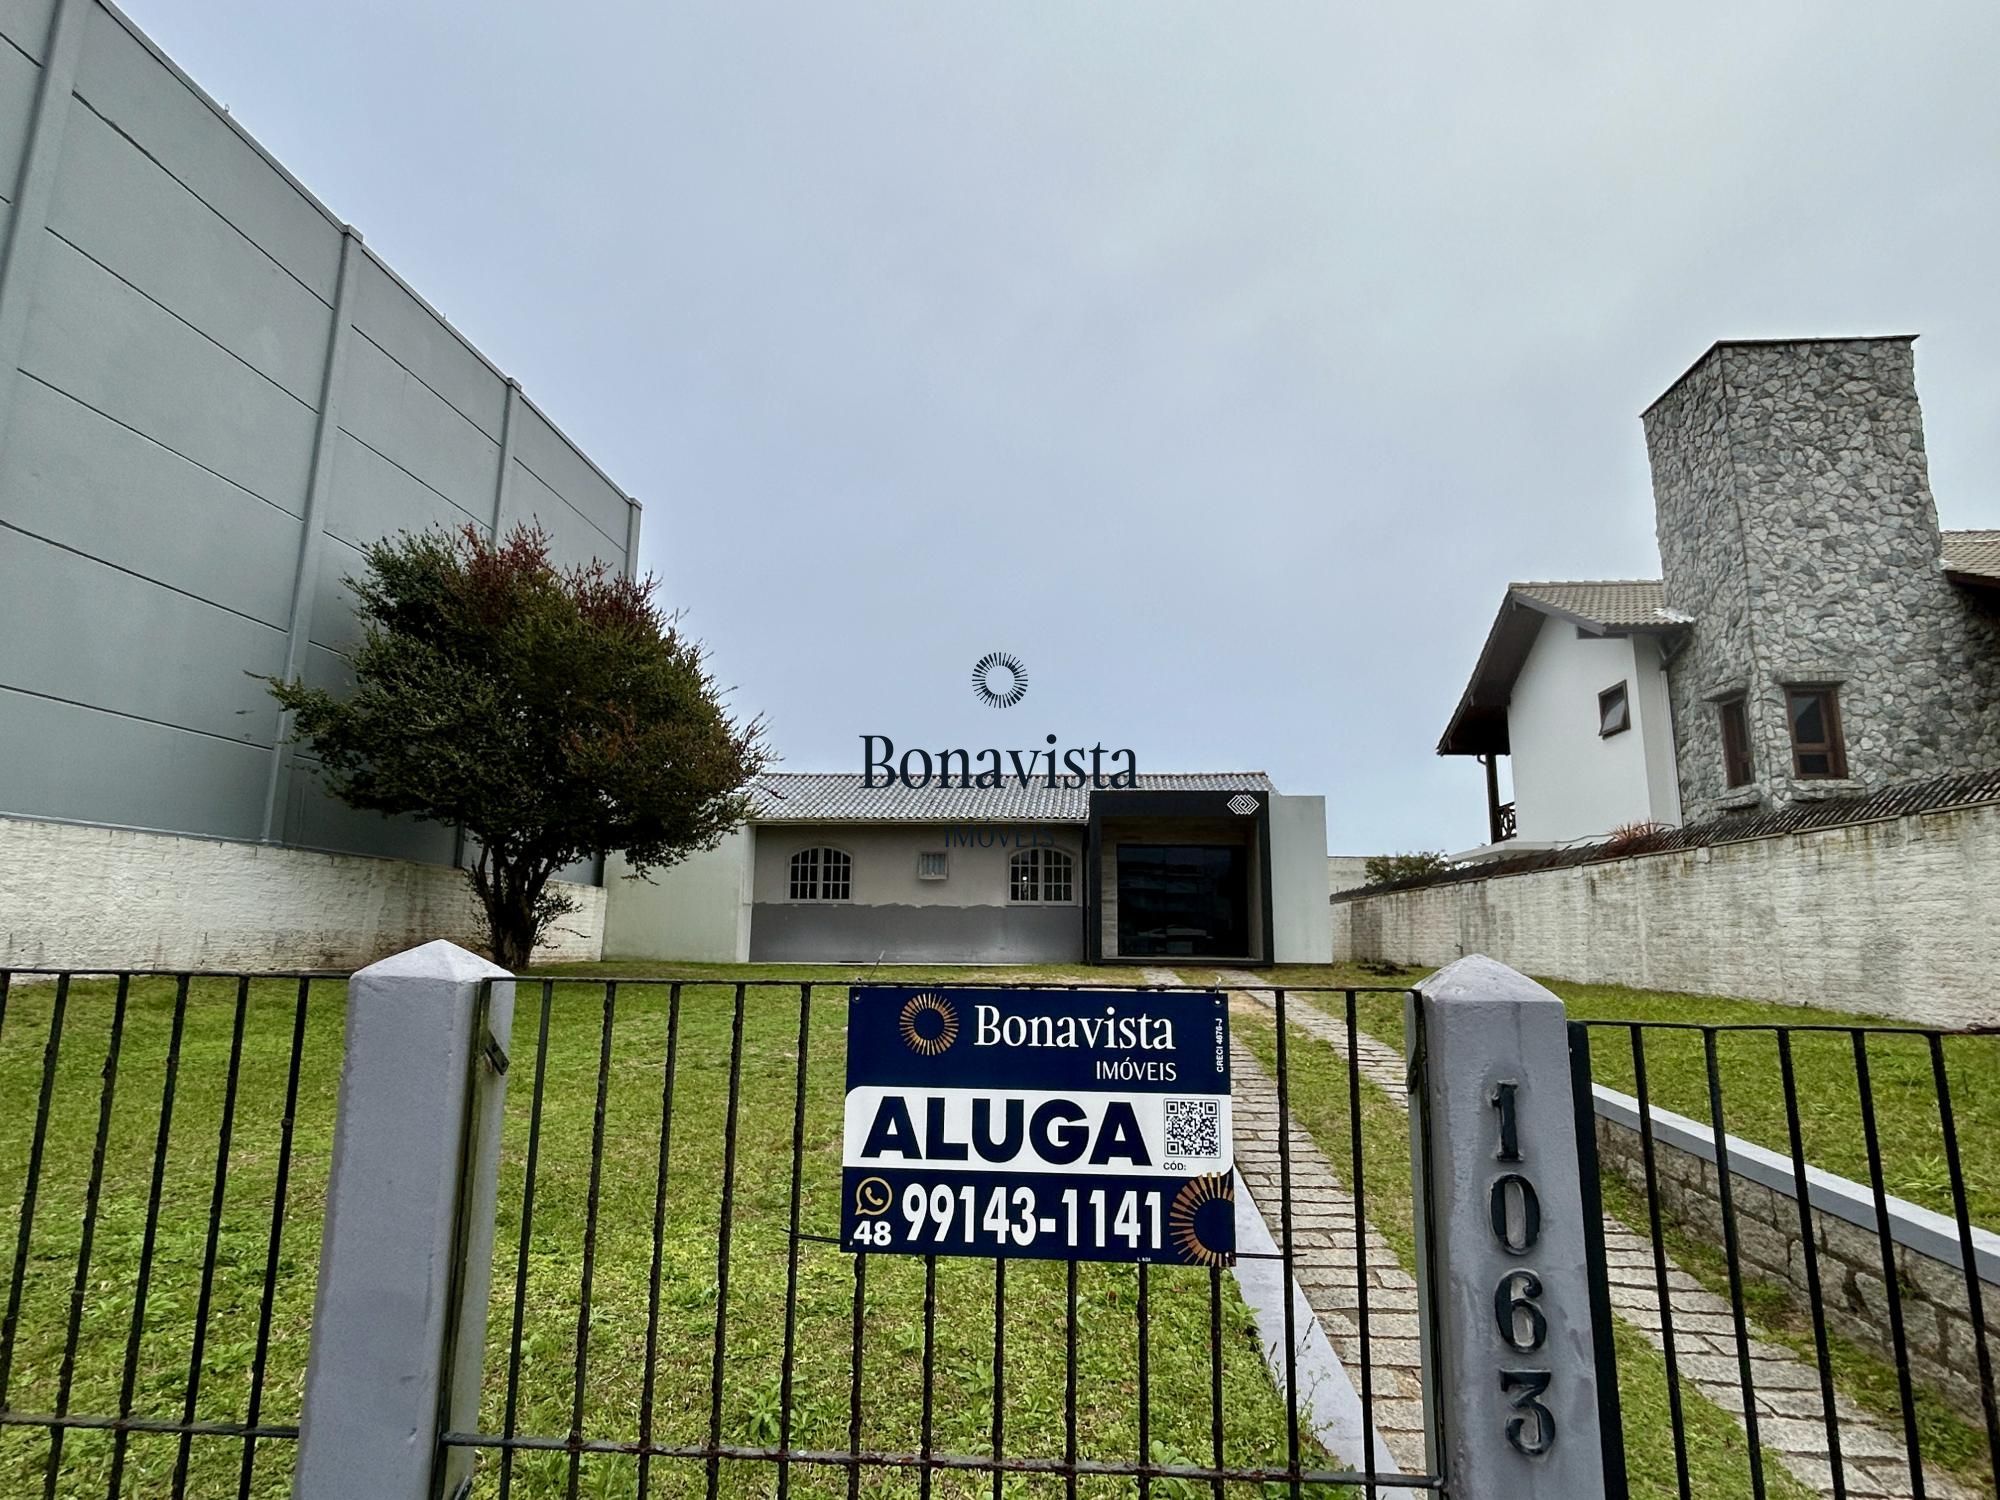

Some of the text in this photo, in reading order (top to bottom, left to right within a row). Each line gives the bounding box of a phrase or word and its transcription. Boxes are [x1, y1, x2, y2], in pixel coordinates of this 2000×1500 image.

[974, 1004, 1176, 1050] Bonavista
[1096, 1057, 1177, 1082] IMÓVEIS
[1215, 1046, 1224, 1073] CRECI
[860, 1095, 1152, 1167] ALUGA
[1163, 1160, 1187, 1171] CÓD:
[853, 1182, 1162, 1249] 48 99143-1141
[1488, 1080, 1557, 1457] 1063
